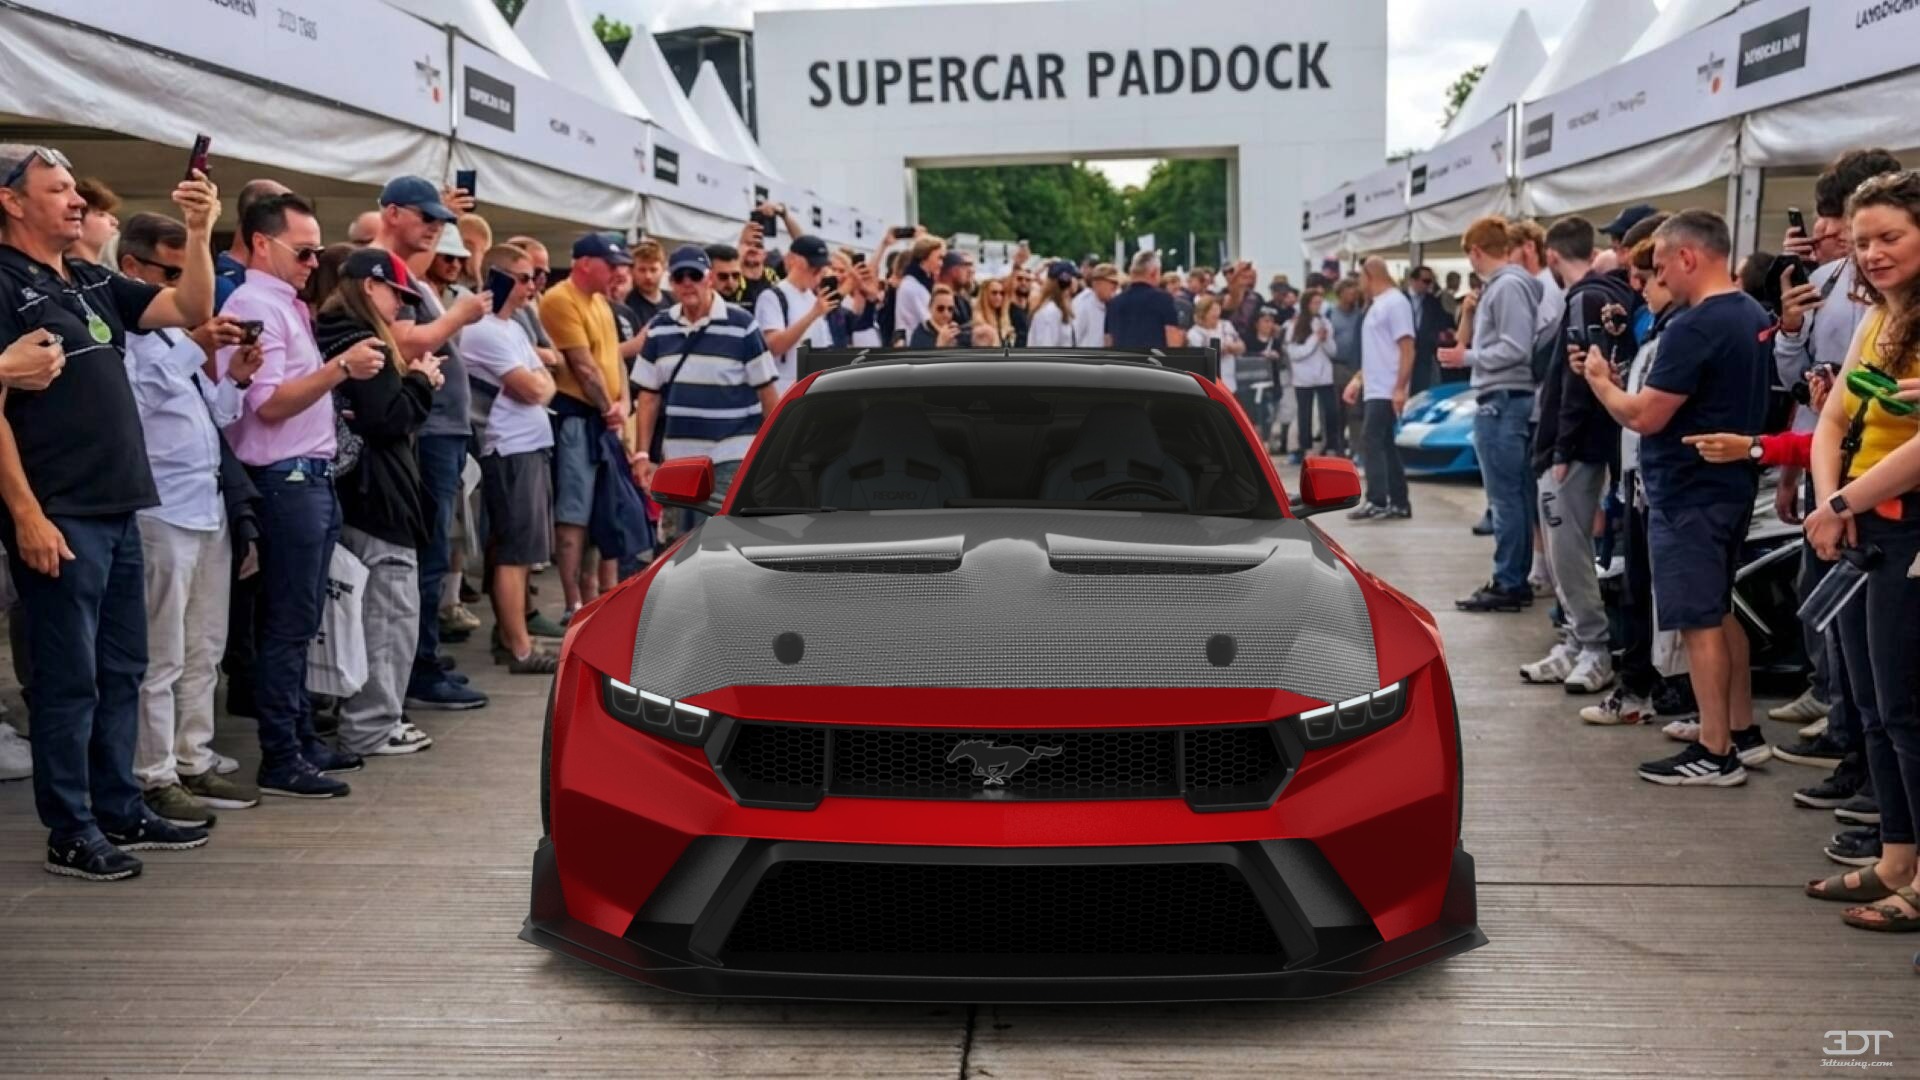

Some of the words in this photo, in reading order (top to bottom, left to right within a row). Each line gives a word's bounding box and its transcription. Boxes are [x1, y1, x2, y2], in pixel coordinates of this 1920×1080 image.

[808, 52, 1067, 108] SUPERCAR
[1087, 41, 1331, 99] PADDOCK
[872, 490, 918, 500] RECARO
